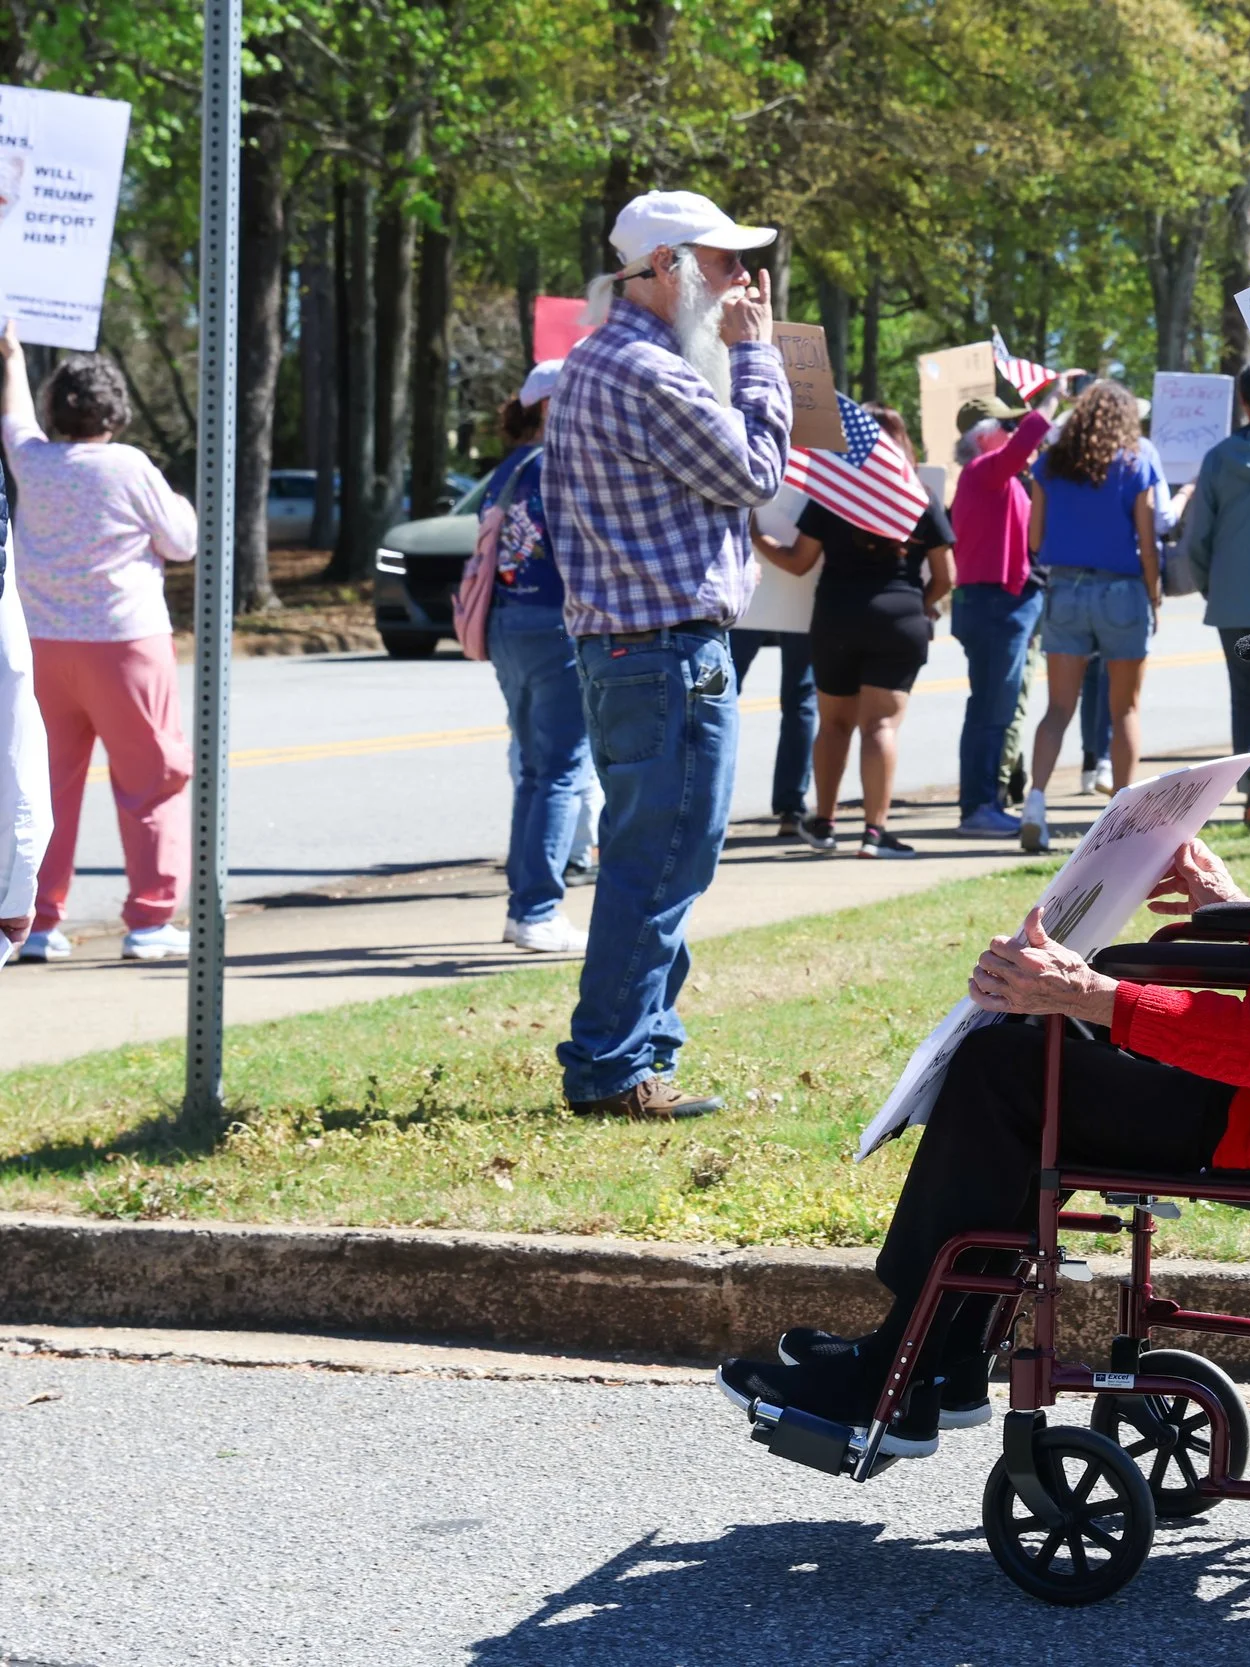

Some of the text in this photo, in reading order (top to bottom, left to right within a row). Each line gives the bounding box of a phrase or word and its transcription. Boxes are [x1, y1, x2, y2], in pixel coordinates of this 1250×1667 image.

[34, 164, 77, 182] WILL
[33, 185, 95, 203] TRUMP
[25, 210, 96, 228] DEPORT
[24, 230, 67, 246] HIM?
[1073, 805, 1130, 865] THIS
